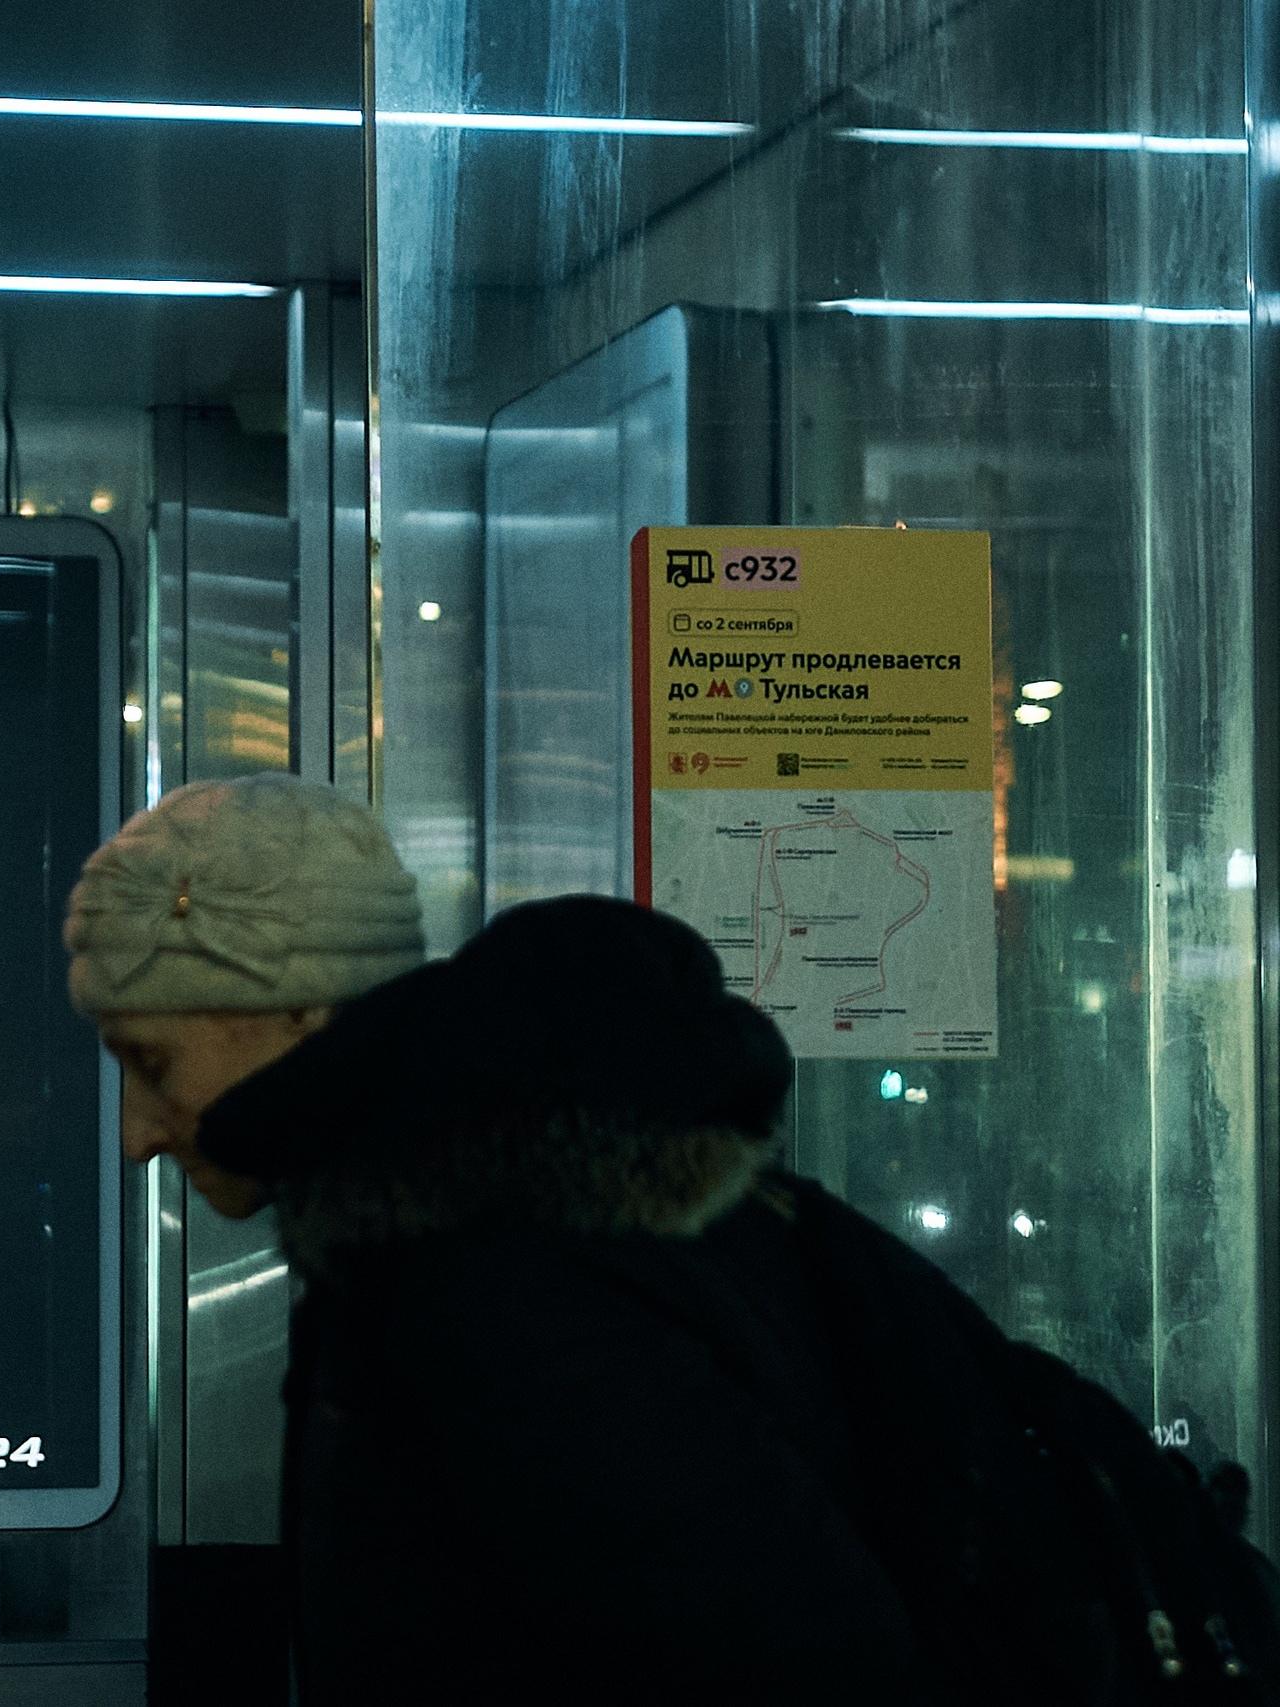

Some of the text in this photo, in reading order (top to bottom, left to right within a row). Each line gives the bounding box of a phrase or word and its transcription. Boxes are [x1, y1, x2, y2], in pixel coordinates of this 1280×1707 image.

[725, 555, 797, 582] с932
[696, 617, 793, 633] со 2 сентября
[668, 647, 961, 673] Маршрут продлевается
[668, 683, 699, 701] до
[759, 678, 869, 703] Тульская
[841, 712, 869, 723] будет
[870, 713, 911, 724] удобнее
[912, 712, 969, 724] добираться
[825, 726, 894, 737] Даниловского
[895, 726, 931, 737] района
